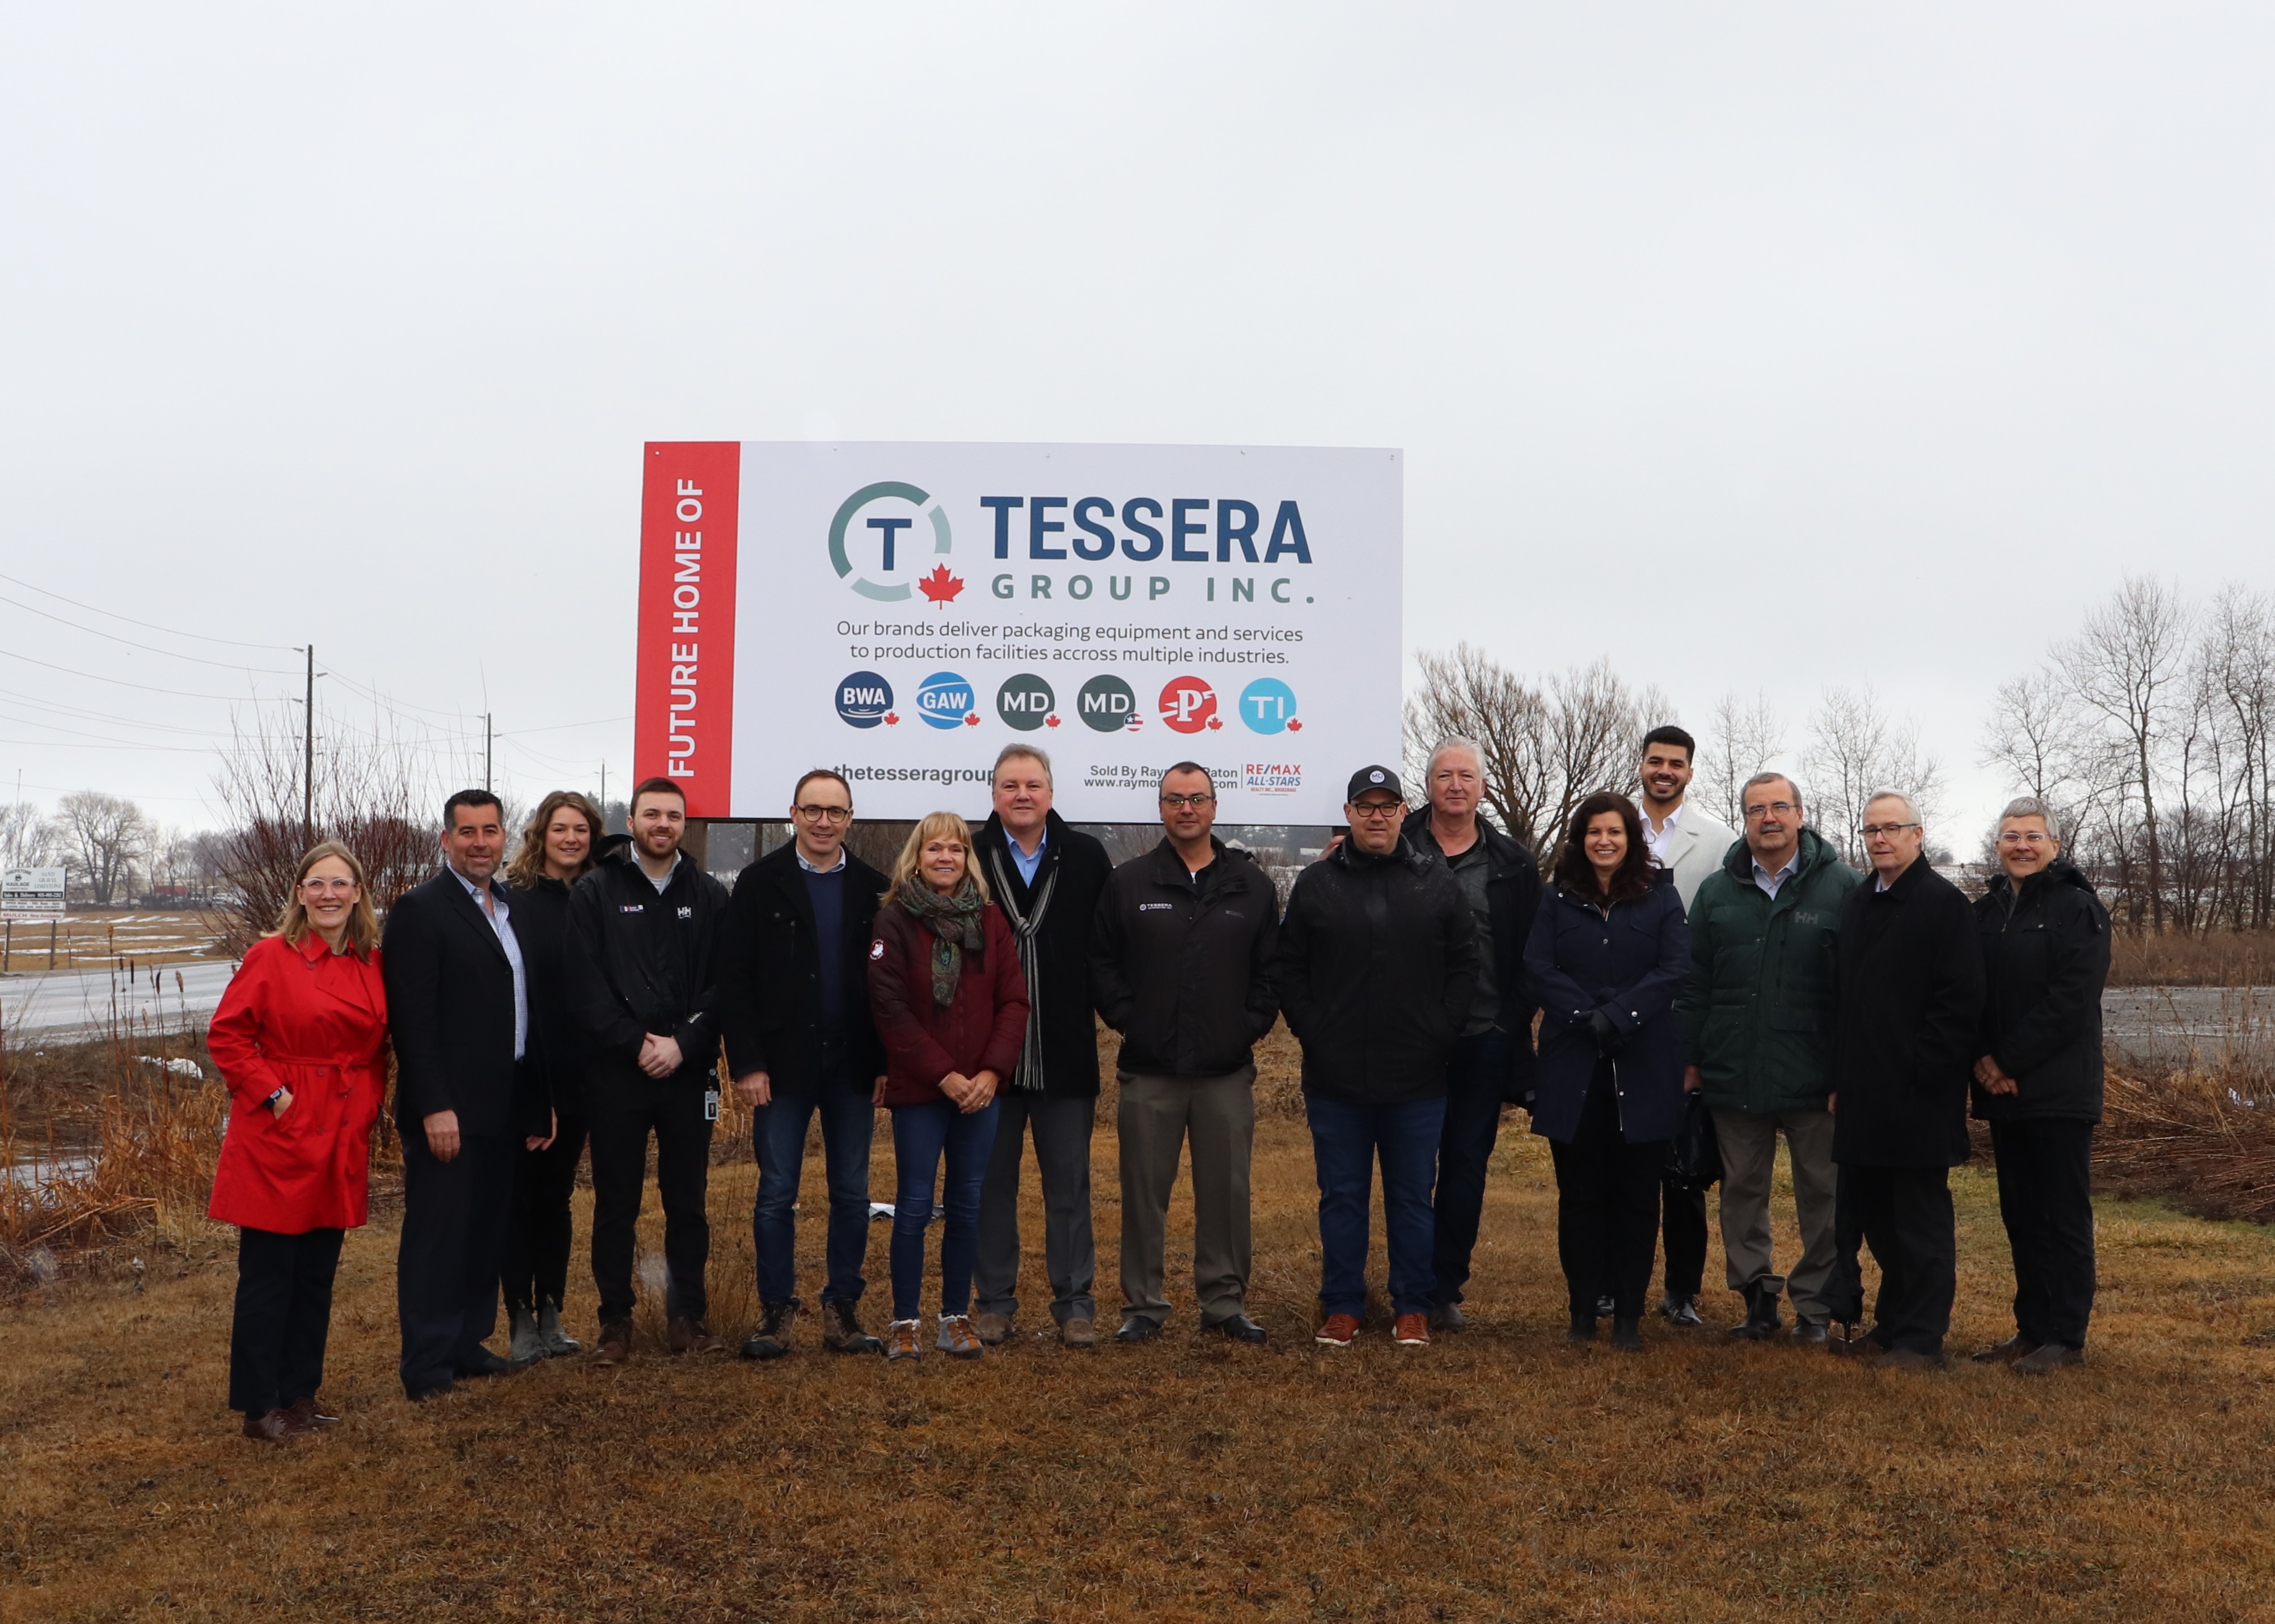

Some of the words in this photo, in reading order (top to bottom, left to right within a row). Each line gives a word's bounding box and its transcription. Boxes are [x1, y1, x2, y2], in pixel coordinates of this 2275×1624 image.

[675, 479, 703, 522] OF
[980, 496, 1313, 564] TESSERA
[866, 518, 912, 571] T
[673, 531, 701, 633] HOME
[992, 574, 1170, 600] GROUP
[1207, 577, 1314, 604] INC.
[837, 621, 869, 635] Our
[874, 621, 934, 636] brands
[940, 621, 998, 637] deliver
[1003, 623, 1090, 641] packaging
[1096, 624, 1191, 642] equipment
[1195, 626, 1228, 640] and
[1233, 626, 1303, 641] services
[850, 645, 869, 658] to
[874, 644, 970, 661] production
[976, 644, 1048, 659] facilities
[1052, 649, 1118, 660] accross
[1123, 647, 1193, 665] multiple
[1199, 647, 1289, 664] industries.
[843, 688, 886, 705] BWA
[923, 692, 967, 709] GAW
[1003, 692, 1049, 712] MD
[1084, 693, 1130, 713] MD
[1177, 689, 1203, 722] P
[668, 643, 698, 777] FUTURE
[1249, 696, 1284, 719] TI
[1090, 765, 1118, 776] Sold
[1122, 766, 1138, 779] By
[1246, 764, 1301, 775] RE/MAX
[1247, 776, 1301, 786] ALL-STARS
[1795, 911, 1819, 924] HH
